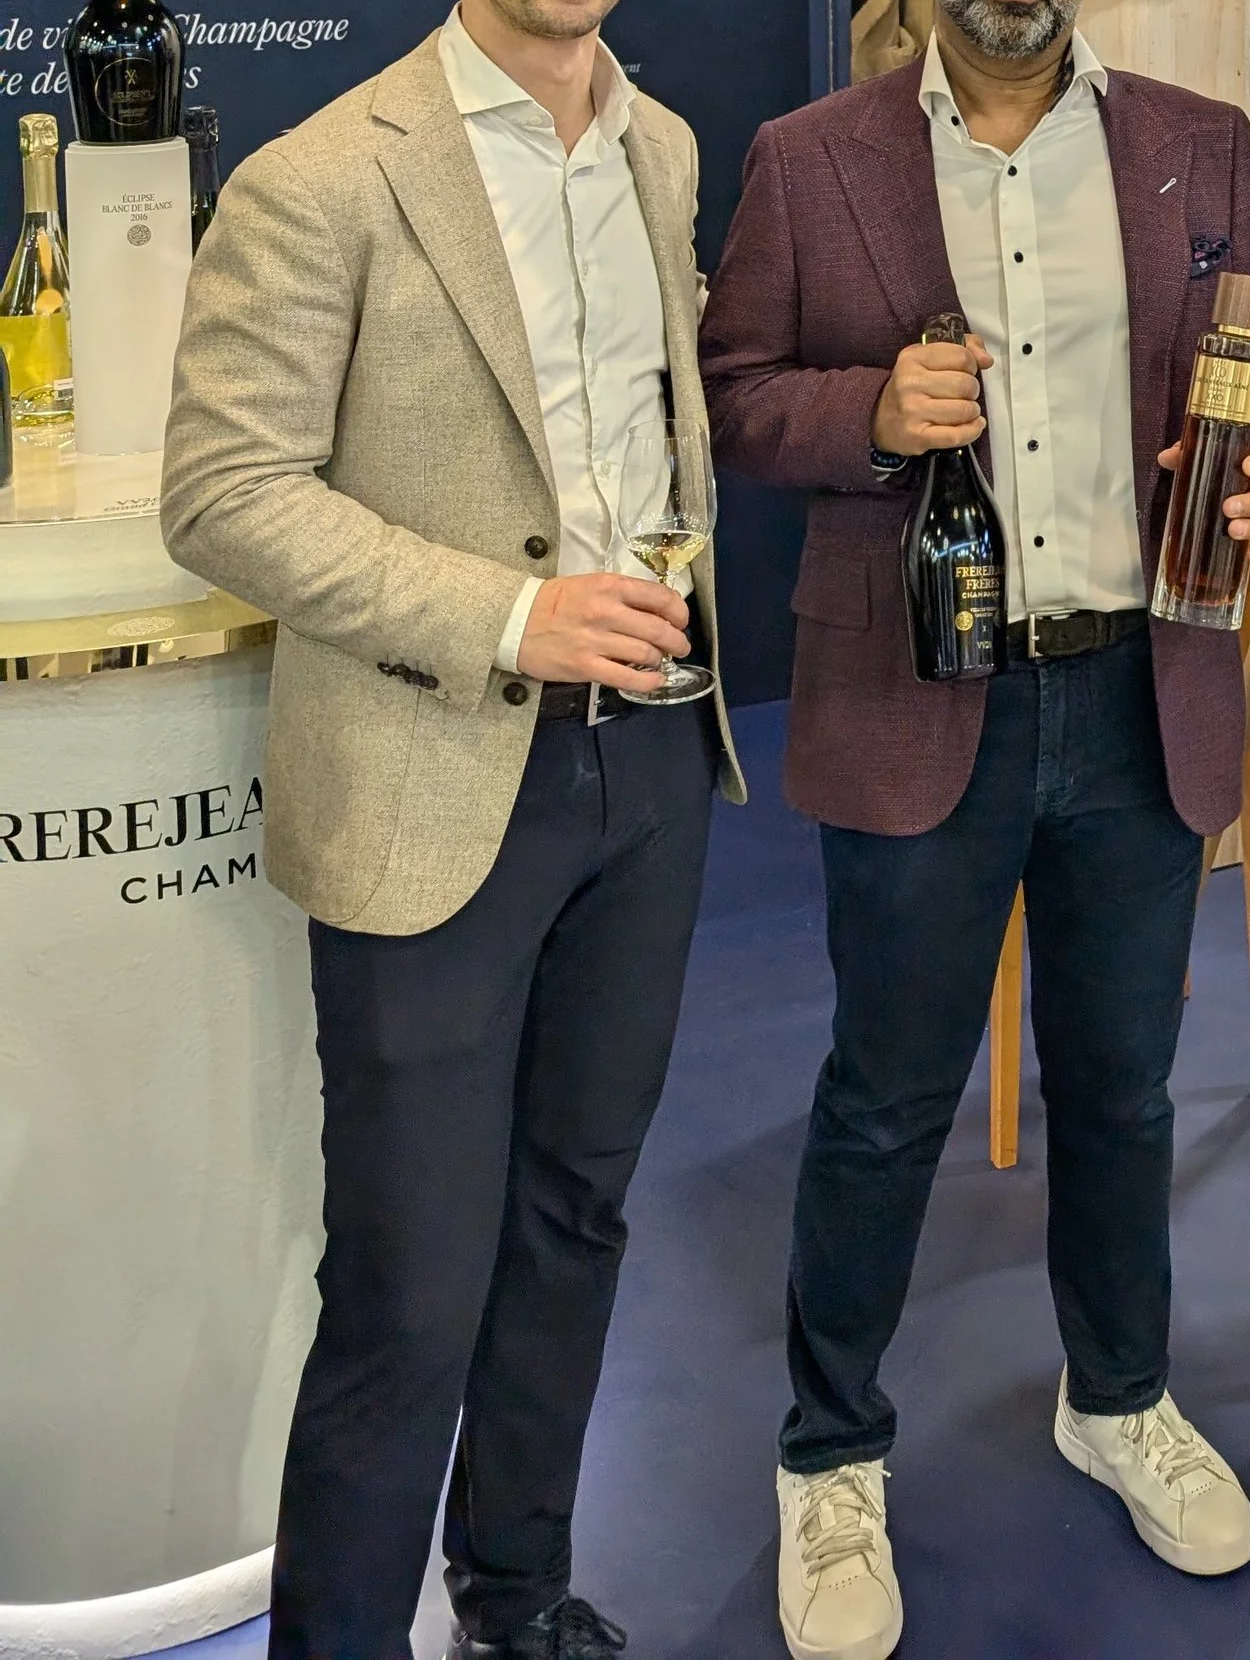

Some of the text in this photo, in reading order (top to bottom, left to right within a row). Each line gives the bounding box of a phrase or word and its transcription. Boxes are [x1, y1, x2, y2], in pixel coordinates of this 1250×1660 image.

[122, 193, 155, 203] ÉCLIPSE
[102, 201, 173, 213] BLANC DE BLANCS
[130, 213, 148, 222] 2016
